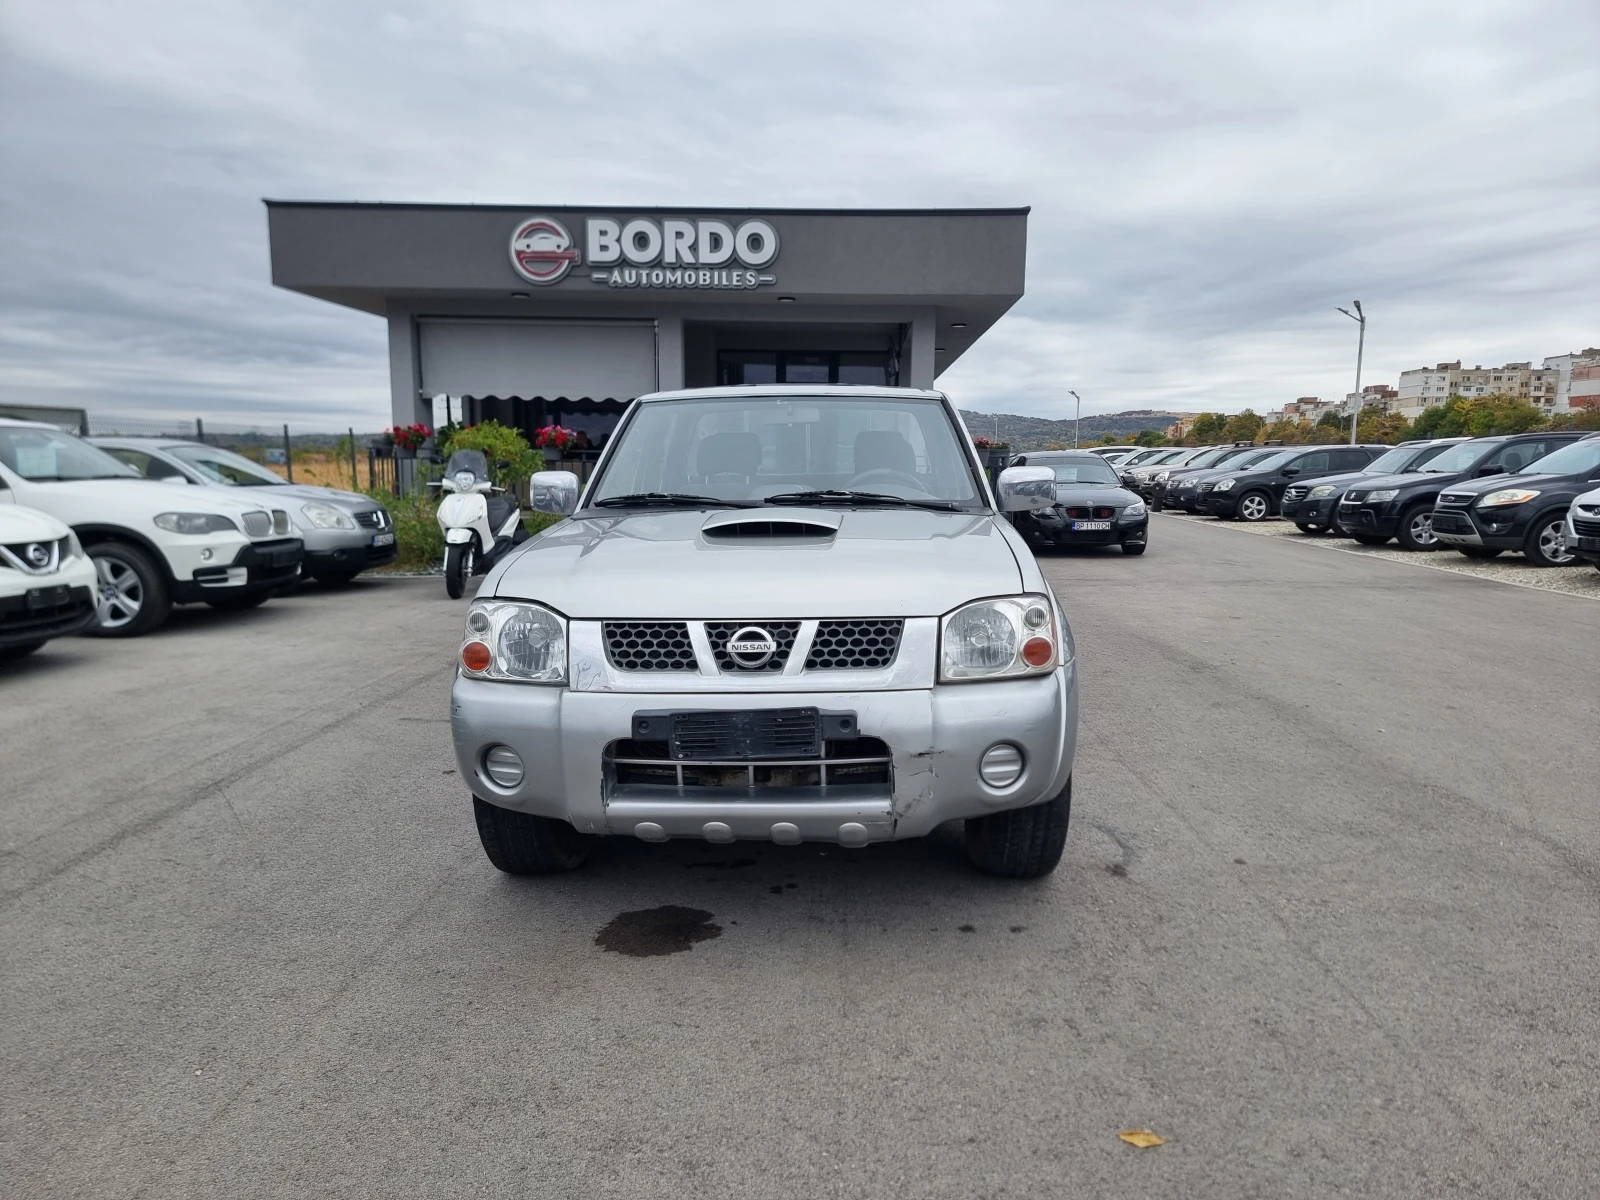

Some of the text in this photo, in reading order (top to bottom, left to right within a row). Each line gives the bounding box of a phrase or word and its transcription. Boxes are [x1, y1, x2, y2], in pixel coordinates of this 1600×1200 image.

[586, 219, 776, 265] BORDO
[610, 270, 756, 286] AUTOMOBILES
[731, 643, 771, 651] NISSAN
